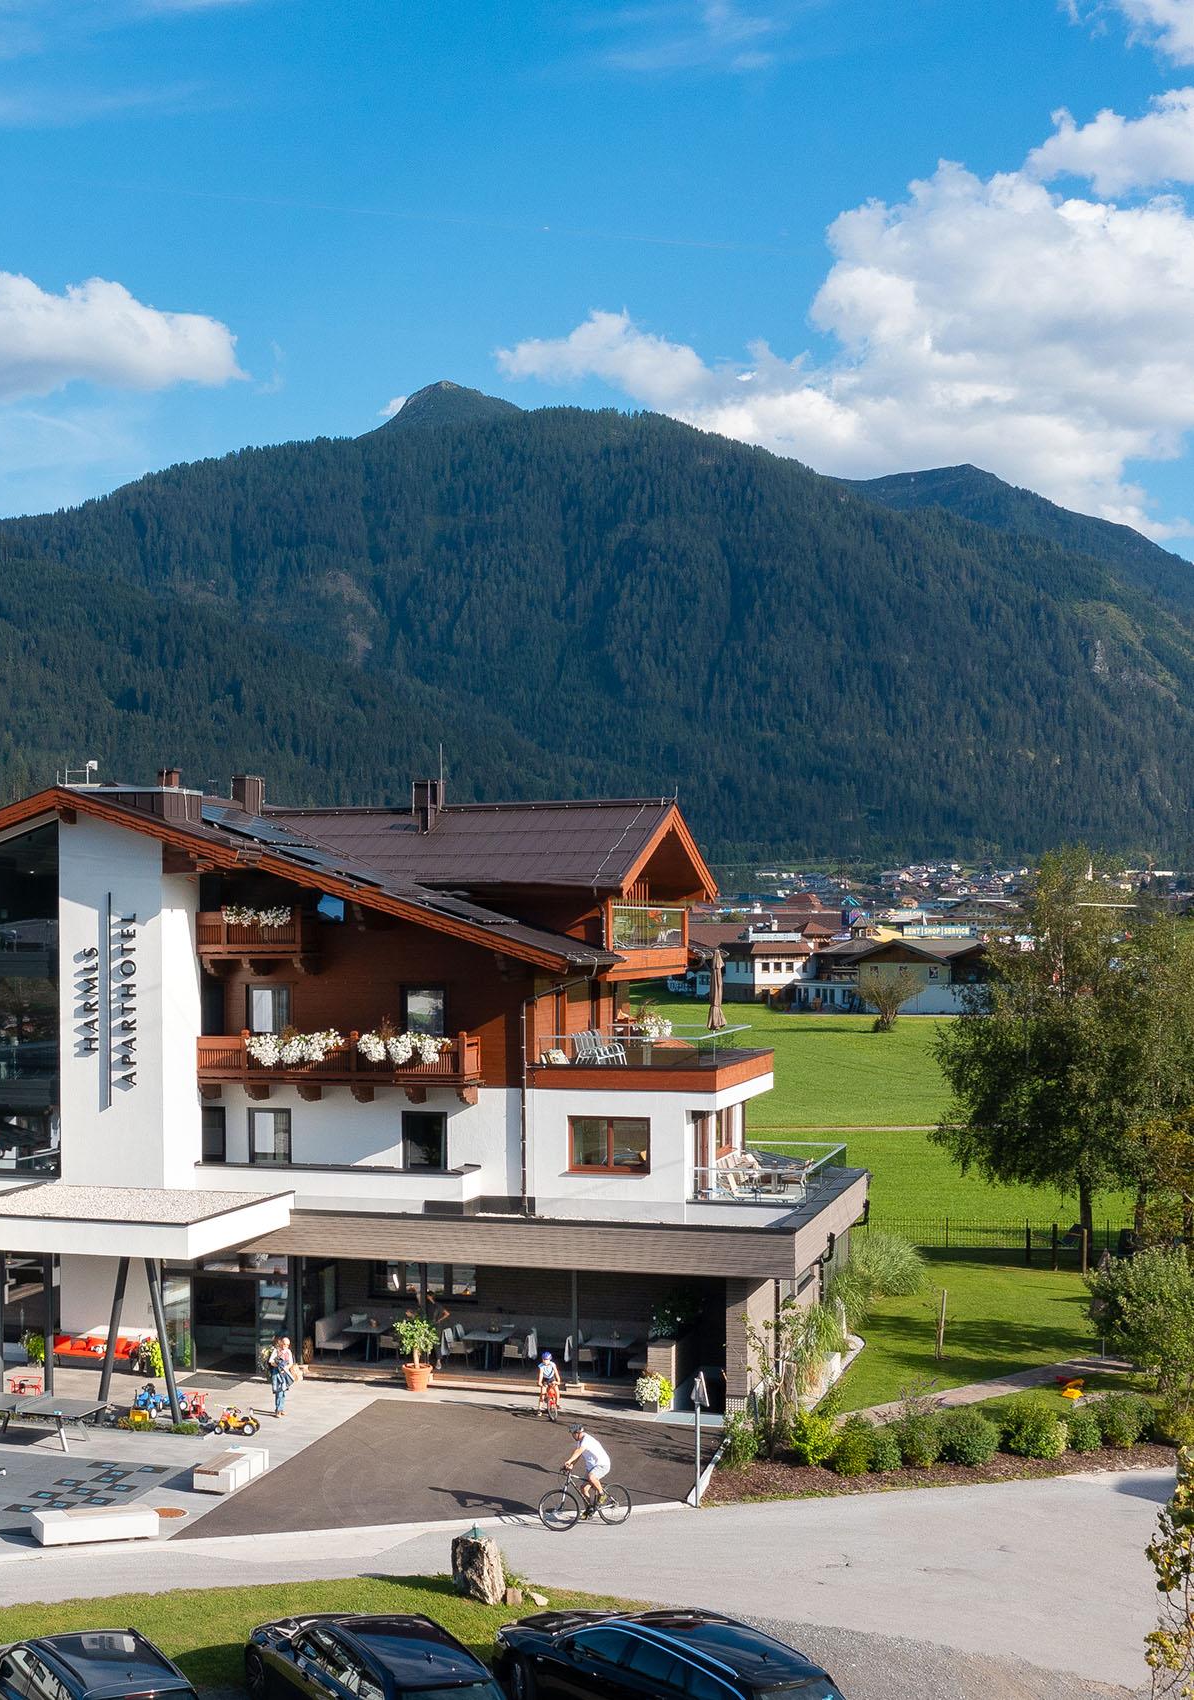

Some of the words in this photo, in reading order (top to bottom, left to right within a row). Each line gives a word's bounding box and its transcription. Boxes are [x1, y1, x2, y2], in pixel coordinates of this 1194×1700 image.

[903, 927, 920, 935] RENT
[924, 927, 940, 935] SHOP
[944, 927, 970, 935] SERVICE
[83, 947, 99, 1052] HARMLS
[121, 913, 137, 1086] APARTHOTEL
